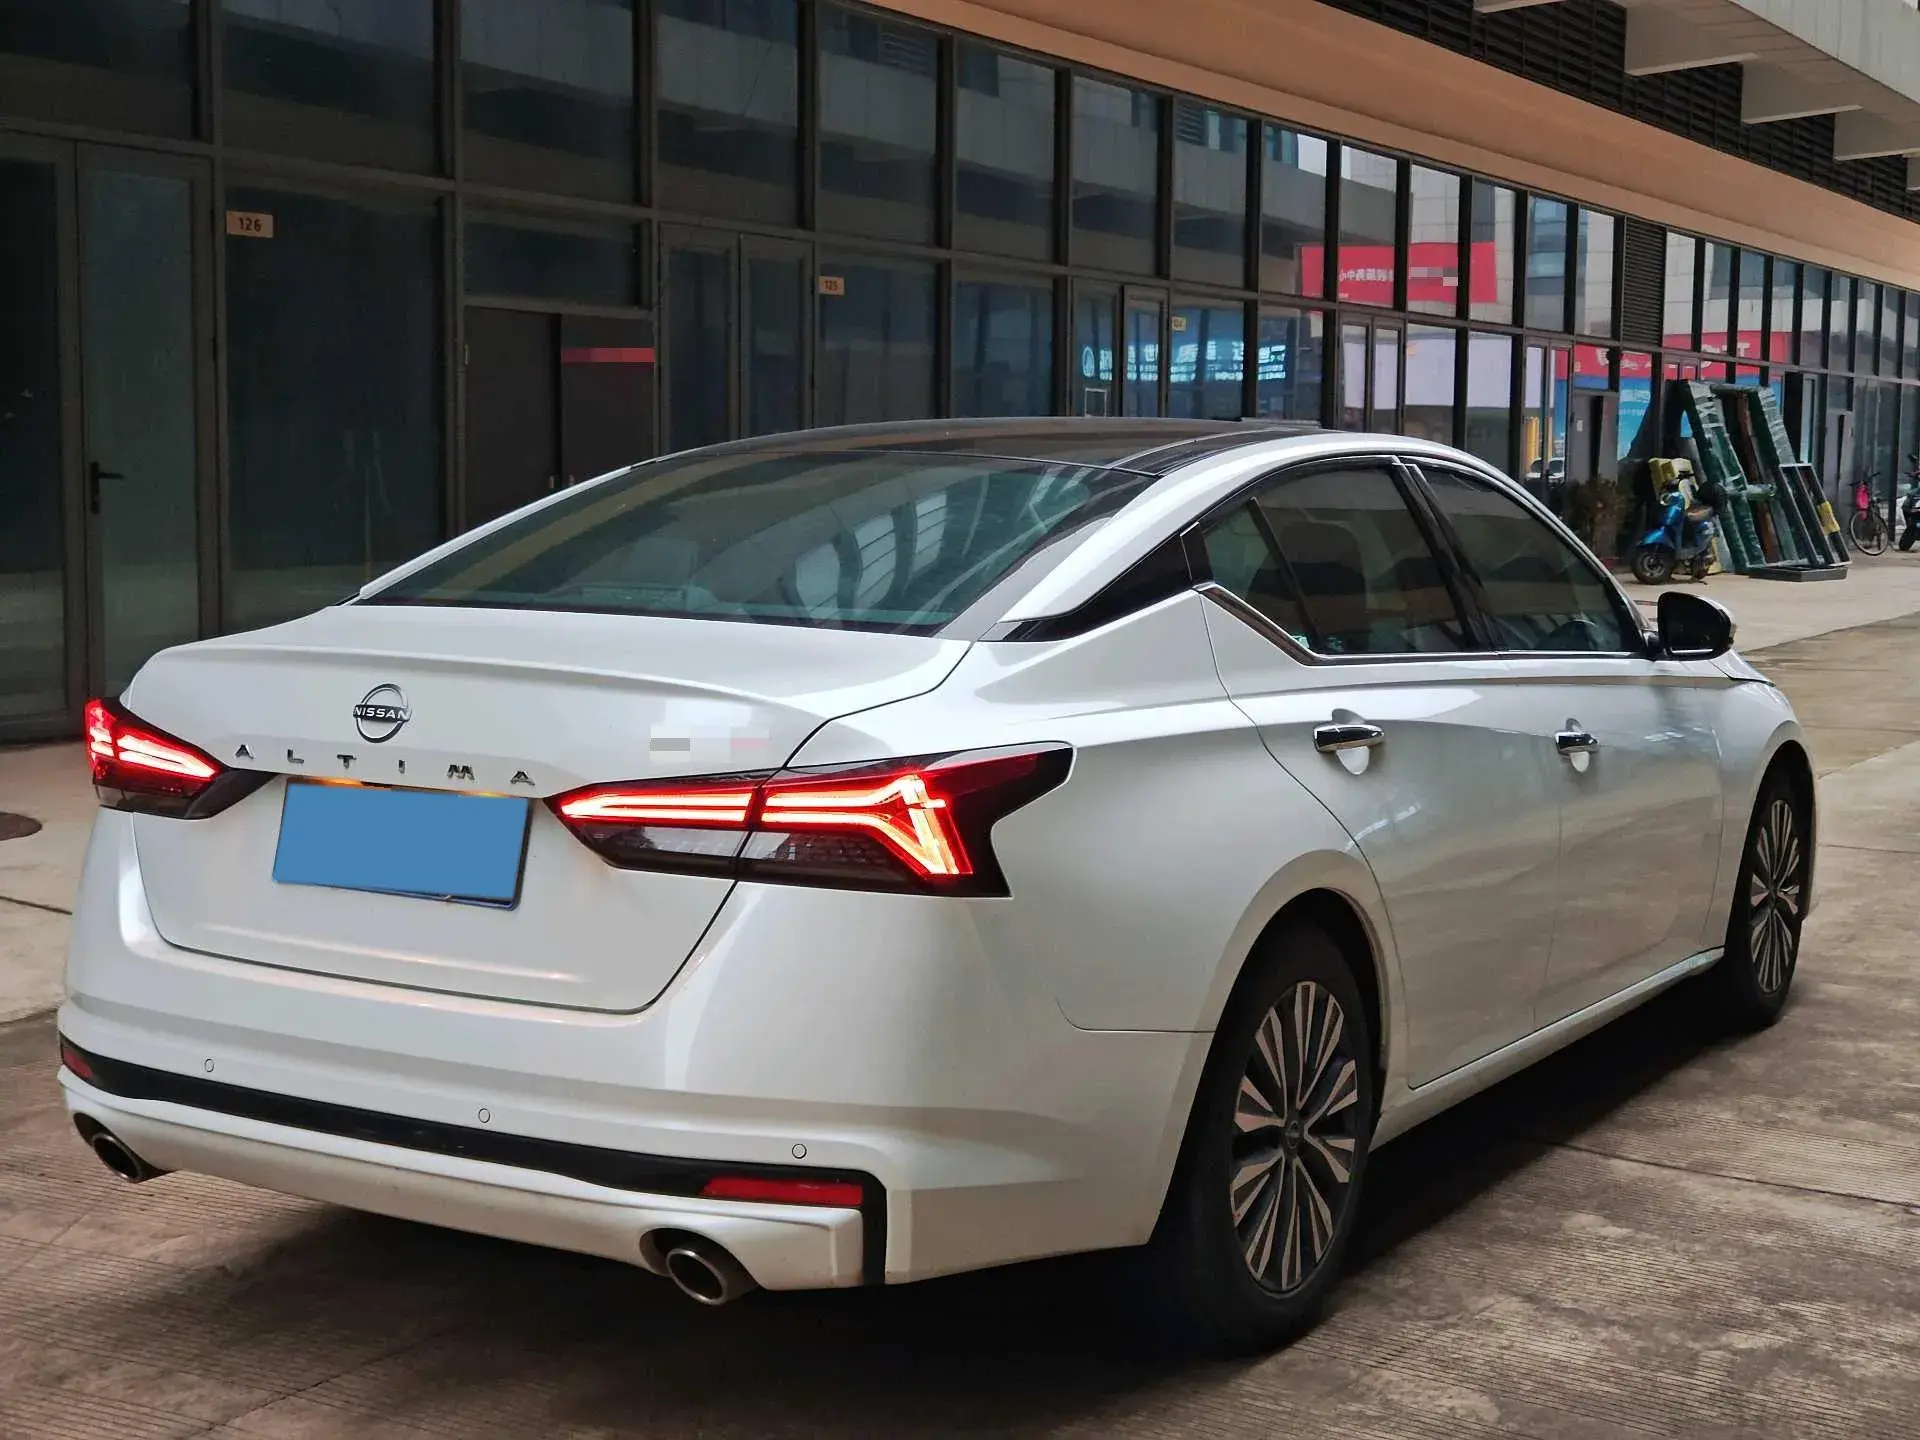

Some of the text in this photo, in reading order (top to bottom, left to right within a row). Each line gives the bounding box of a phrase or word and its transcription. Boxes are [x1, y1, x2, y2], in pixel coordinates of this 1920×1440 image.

[239, 217, 262, 232] 126
[355, 706, 408, 721] NISSAN
[235, 743, 536, 787] ALTIMA
